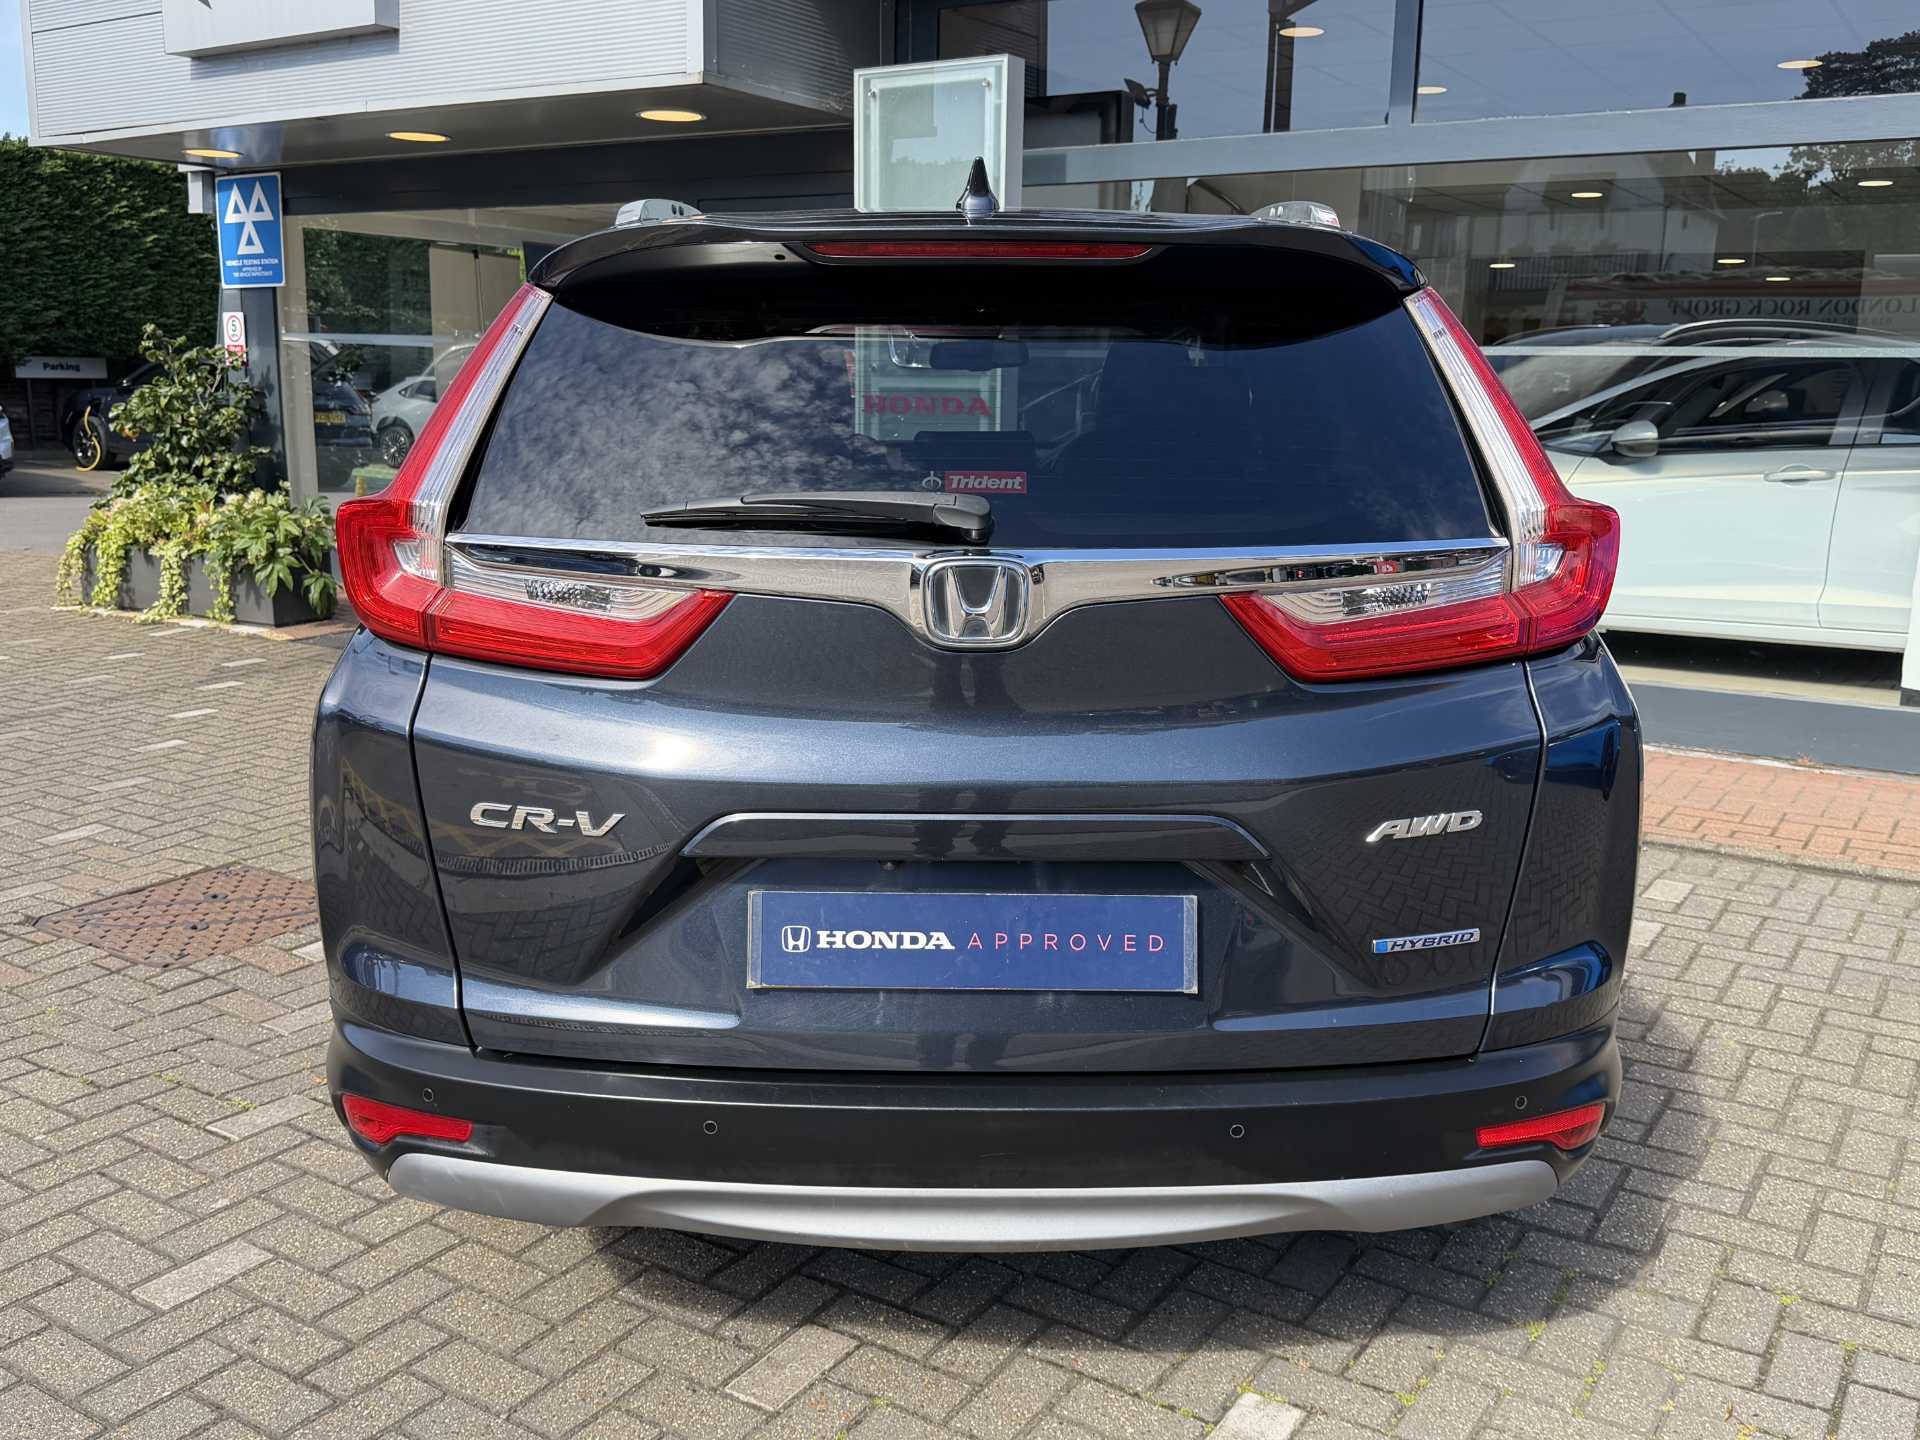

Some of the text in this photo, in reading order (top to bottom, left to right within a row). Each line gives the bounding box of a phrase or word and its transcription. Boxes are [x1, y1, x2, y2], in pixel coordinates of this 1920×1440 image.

[231, 319, 238, 332] 5
[42, 361, 81, 373] Parking
[863, 394, 992, 417] HONDA
[949, 474, 1024, 490] Trident
[470, 802, 626, 837] CR-V
[1366, 810, 1484, 842] AWD
[816, 930, 956, 950] HONDA
[967, 932, 1164, 951] APPROVED
[1390, 931, 1475, 950] HYBRID
